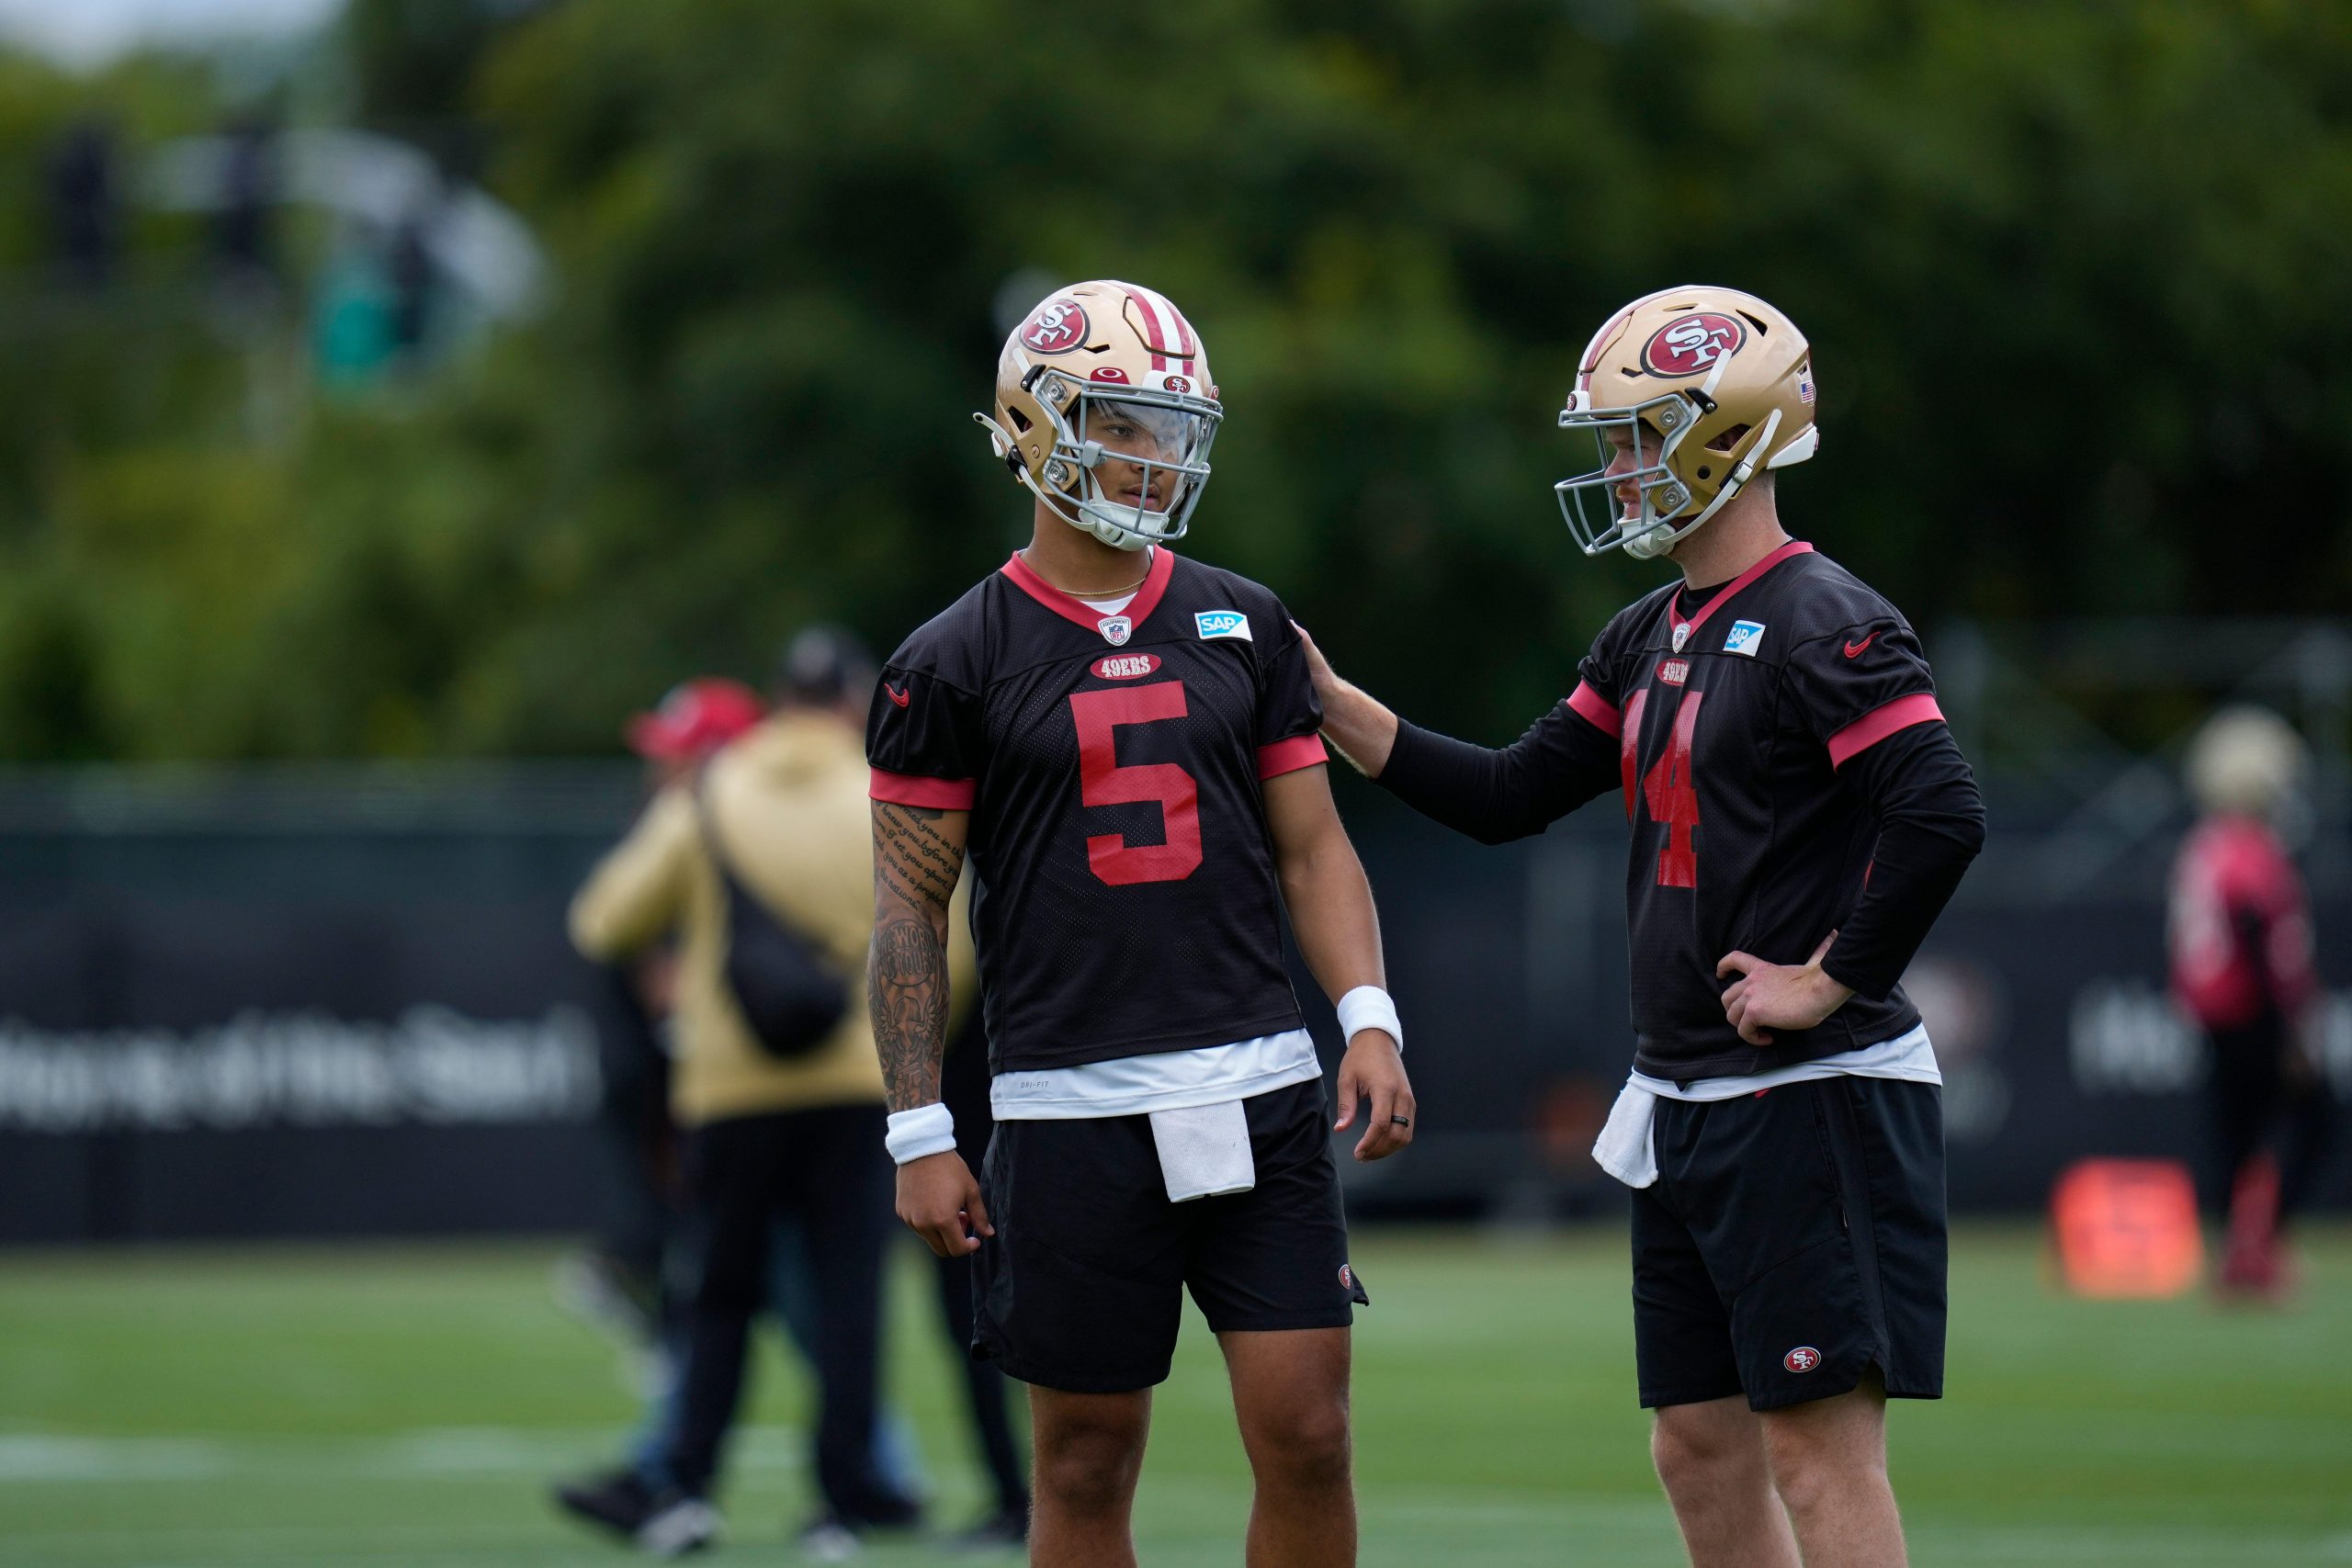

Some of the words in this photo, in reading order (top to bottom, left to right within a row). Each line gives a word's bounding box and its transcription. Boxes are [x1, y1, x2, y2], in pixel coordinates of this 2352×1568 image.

[1200, 616, 1238, 632] SAP
[1728, 628, 1748, 644] SAP
[1101, 655, 1151, 678] 49ERS
[1069, 681, 1204, 886] 5
[1021, 1080, 1049, 1089] DRI-FIT
